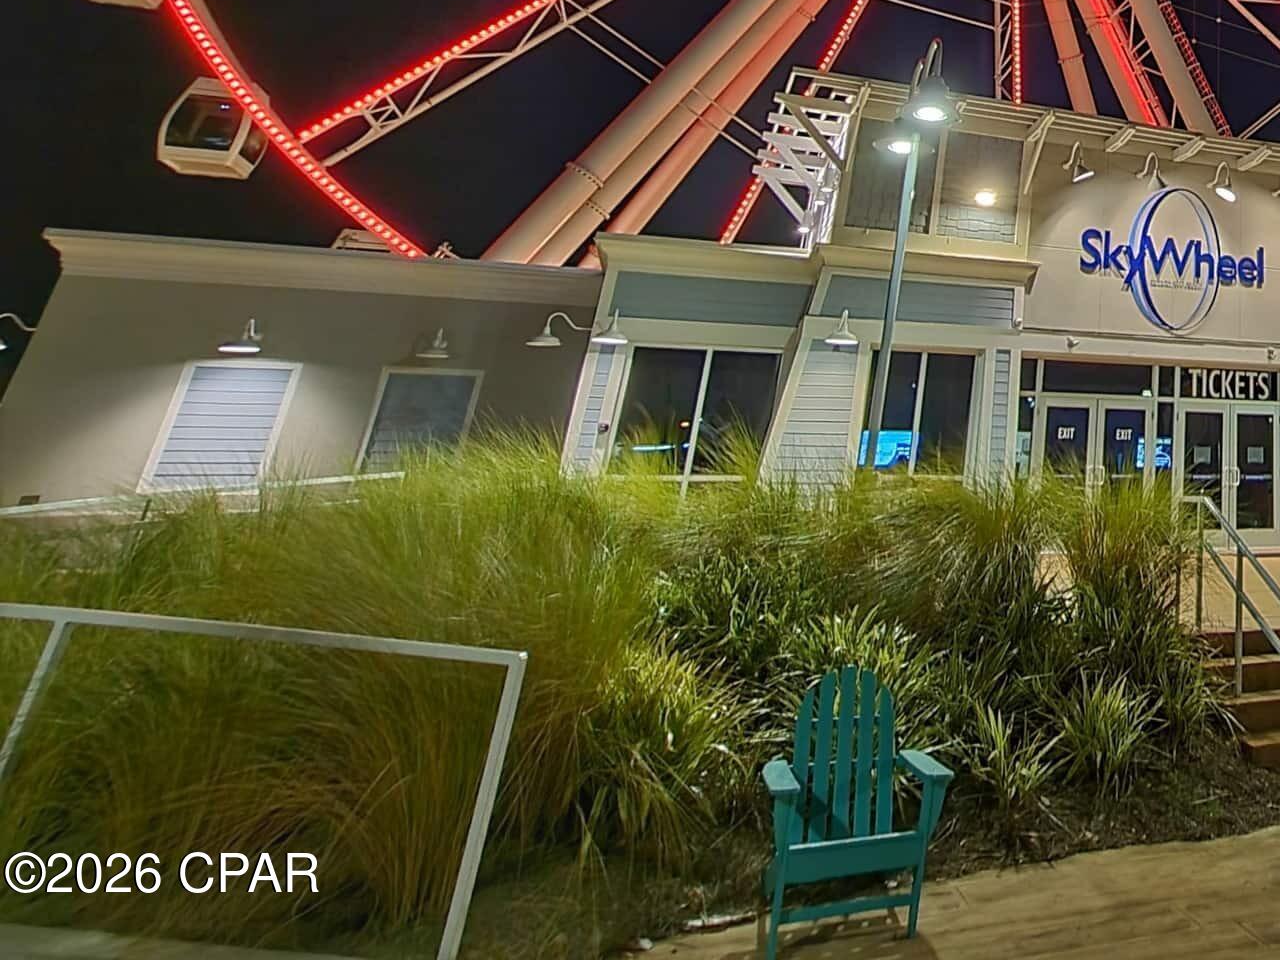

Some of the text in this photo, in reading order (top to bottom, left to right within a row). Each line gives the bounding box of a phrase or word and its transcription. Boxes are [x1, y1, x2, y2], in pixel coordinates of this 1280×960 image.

[1080, 229, 1264, 289] SkyWheel
[1188, 368, 1269, 400] TICKETS
[1057, 427, 1075, 440] EXIT
[1116, 428, 1133, 441] EXIT
